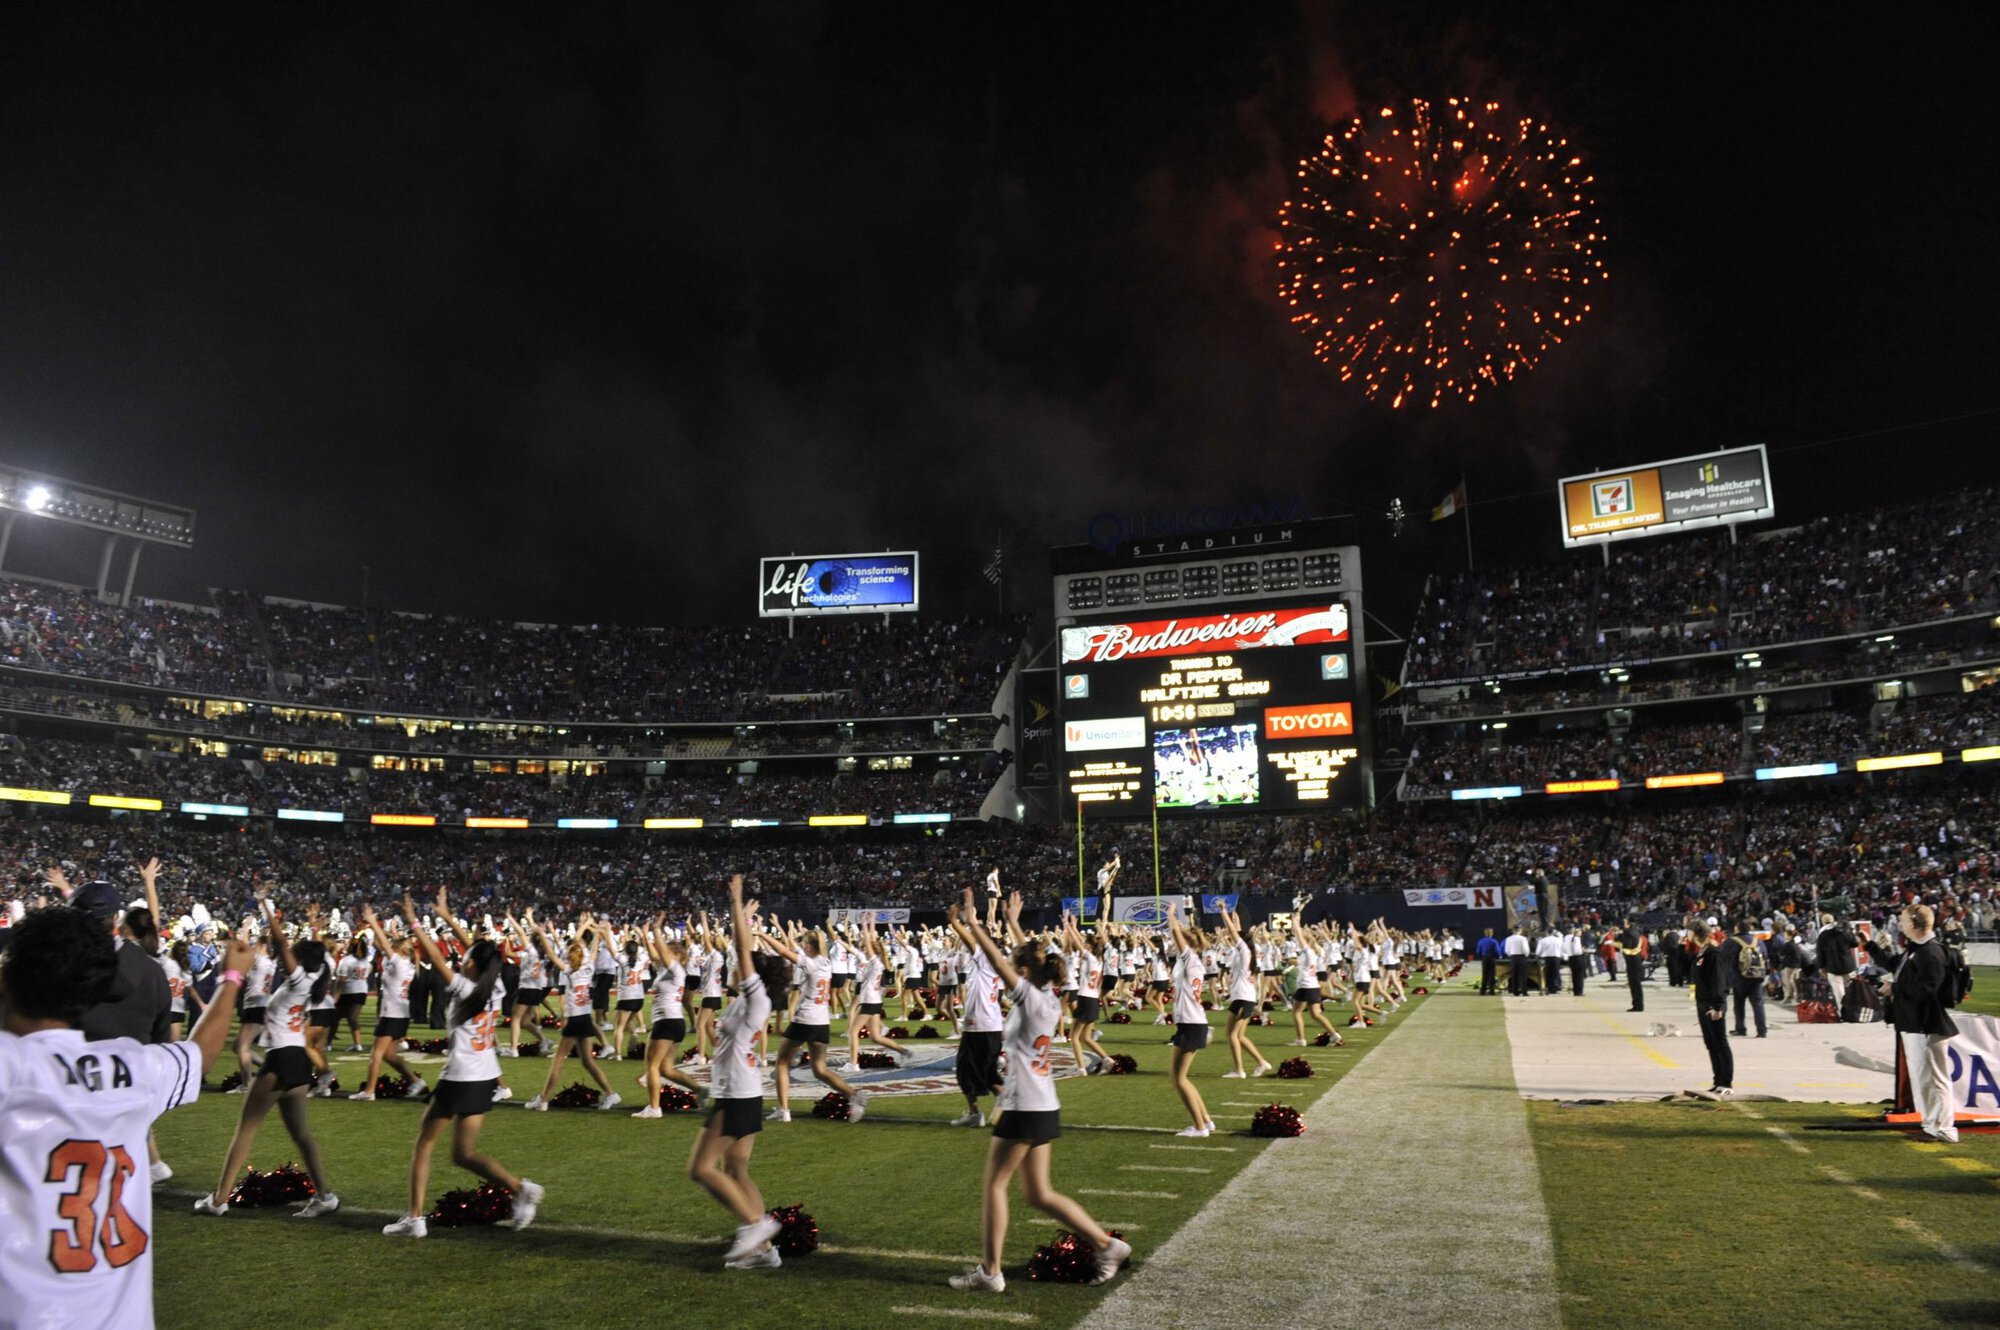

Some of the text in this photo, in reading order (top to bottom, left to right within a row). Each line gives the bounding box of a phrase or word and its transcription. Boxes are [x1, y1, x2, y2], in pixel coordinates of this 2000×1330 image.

[1665, 478, 1762, 501] Imaging Healthcare
[1673, 496, 1755, 515] Your Partner in Health
[1133, 529, 1293, 555] STADIUM
[846, 565, 909, 577] Transforming
[859, 574, 895, 585] science
[764, 562, 815, 607] life
[800, 591, 857, 604] technologies
[1088, 613, 1276, 662] Budweiser
[1170, 655, 1233, 671] THANKS TO
[1160, 667, 1243, 686] DR PEPPER
[1140, 680, 1270, 702] HALFTIME SHOW
[1269, 712, 1349, 733] TOYOTA
[1024, 727, 1053, 740] Sprint
[1473, 888, 1495, 908] N
[1272, 912, 1292, 929] 25
[43, 1138, 149, 1274] 36
